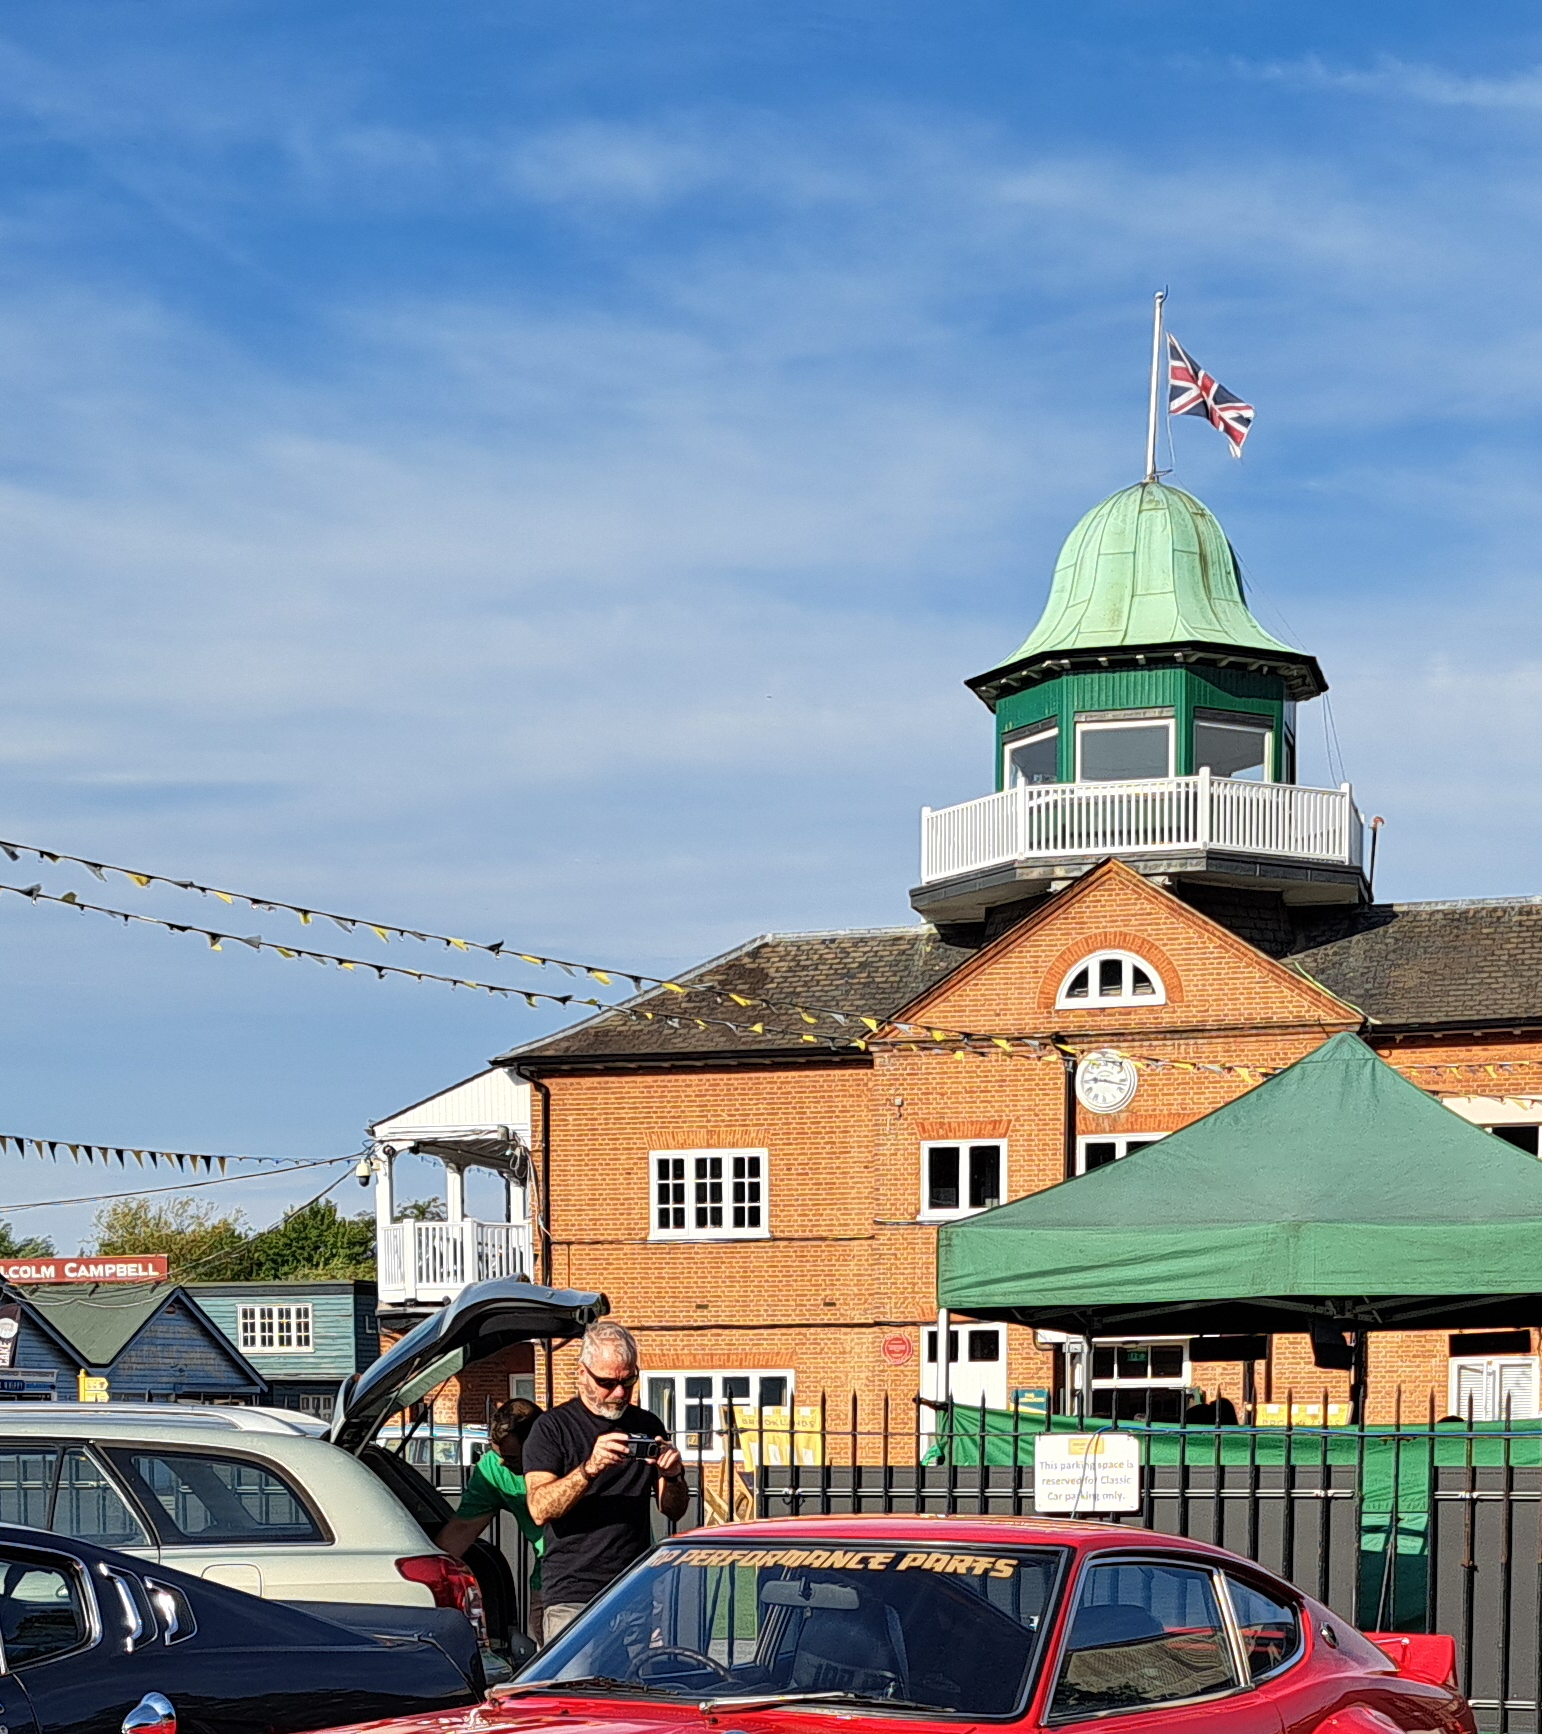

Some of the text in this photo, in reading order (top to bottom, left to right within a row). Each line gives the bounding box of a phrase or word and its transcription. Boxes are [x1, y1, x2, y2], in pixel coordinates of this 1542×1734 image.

[65, 1262, 159, 1277] CAMPBELL
[1039, 1459, 1134, 1471] This parking space is
[1042, 1476, 1083, 1486] reserved
[1100, 1475, 1132, 1485] Classic
[1047, 1491, 1127, 1502] Car parking only.
[672, 1549, 897, 1570] PERFORMANCE
[896, 1552, 1019, 1579] PARTS
